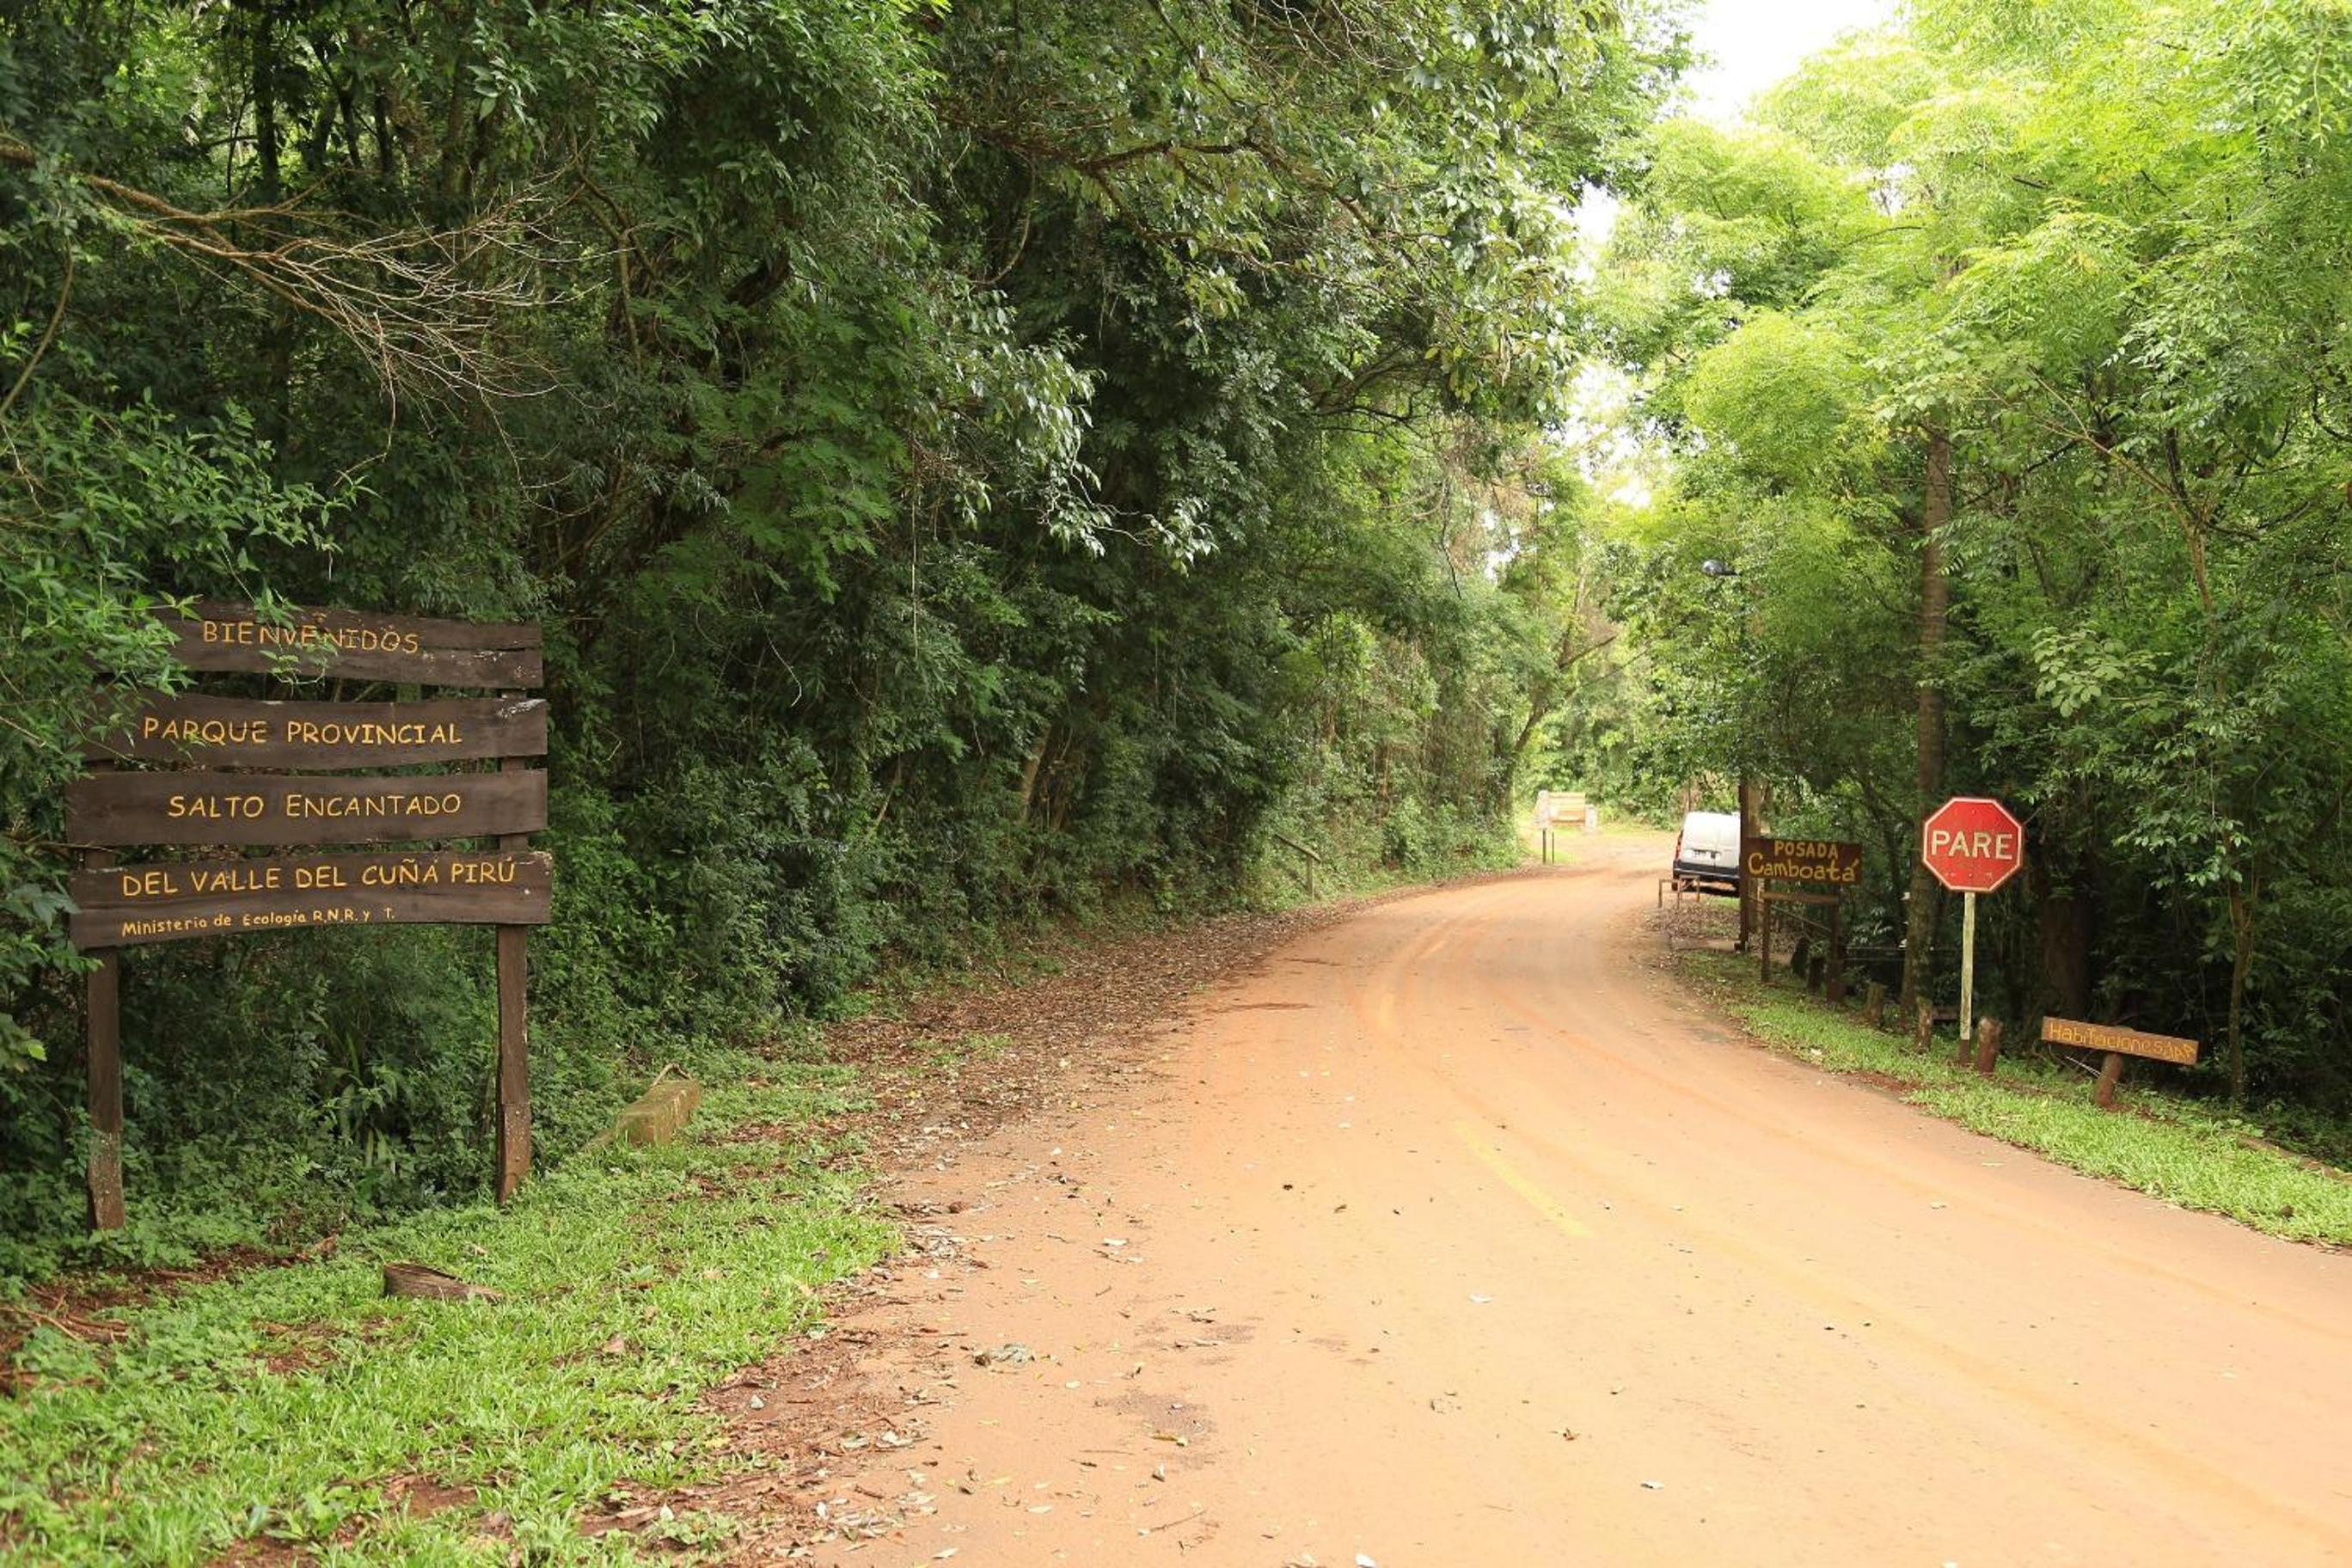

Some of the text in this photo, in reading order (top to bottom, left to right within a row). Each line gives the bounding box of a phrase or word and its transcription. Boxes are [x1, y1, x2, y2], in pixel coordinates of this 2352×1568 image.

[203, 620, 419, 653] BIENVENIDOS
[144, 717, 462, 745] PARQUE PROVINCIAL
[168, 793, 462, 818] SALTO ENCANTADO
[1774, 840, 1839, 859] POSADA
[1931, 830, 2012, 860] PARE
[123, 870, 178, 897] DEL
[190, 867, 281, 891] VALLE
[296, 865, 346, 889] DEL
[450, 856, 516, 884] PIRÚ
[1748, 852, 1859, 882] Camboatá
[121, 916, 208, 938] Ministerio
[214, 913, 232, 927] de
